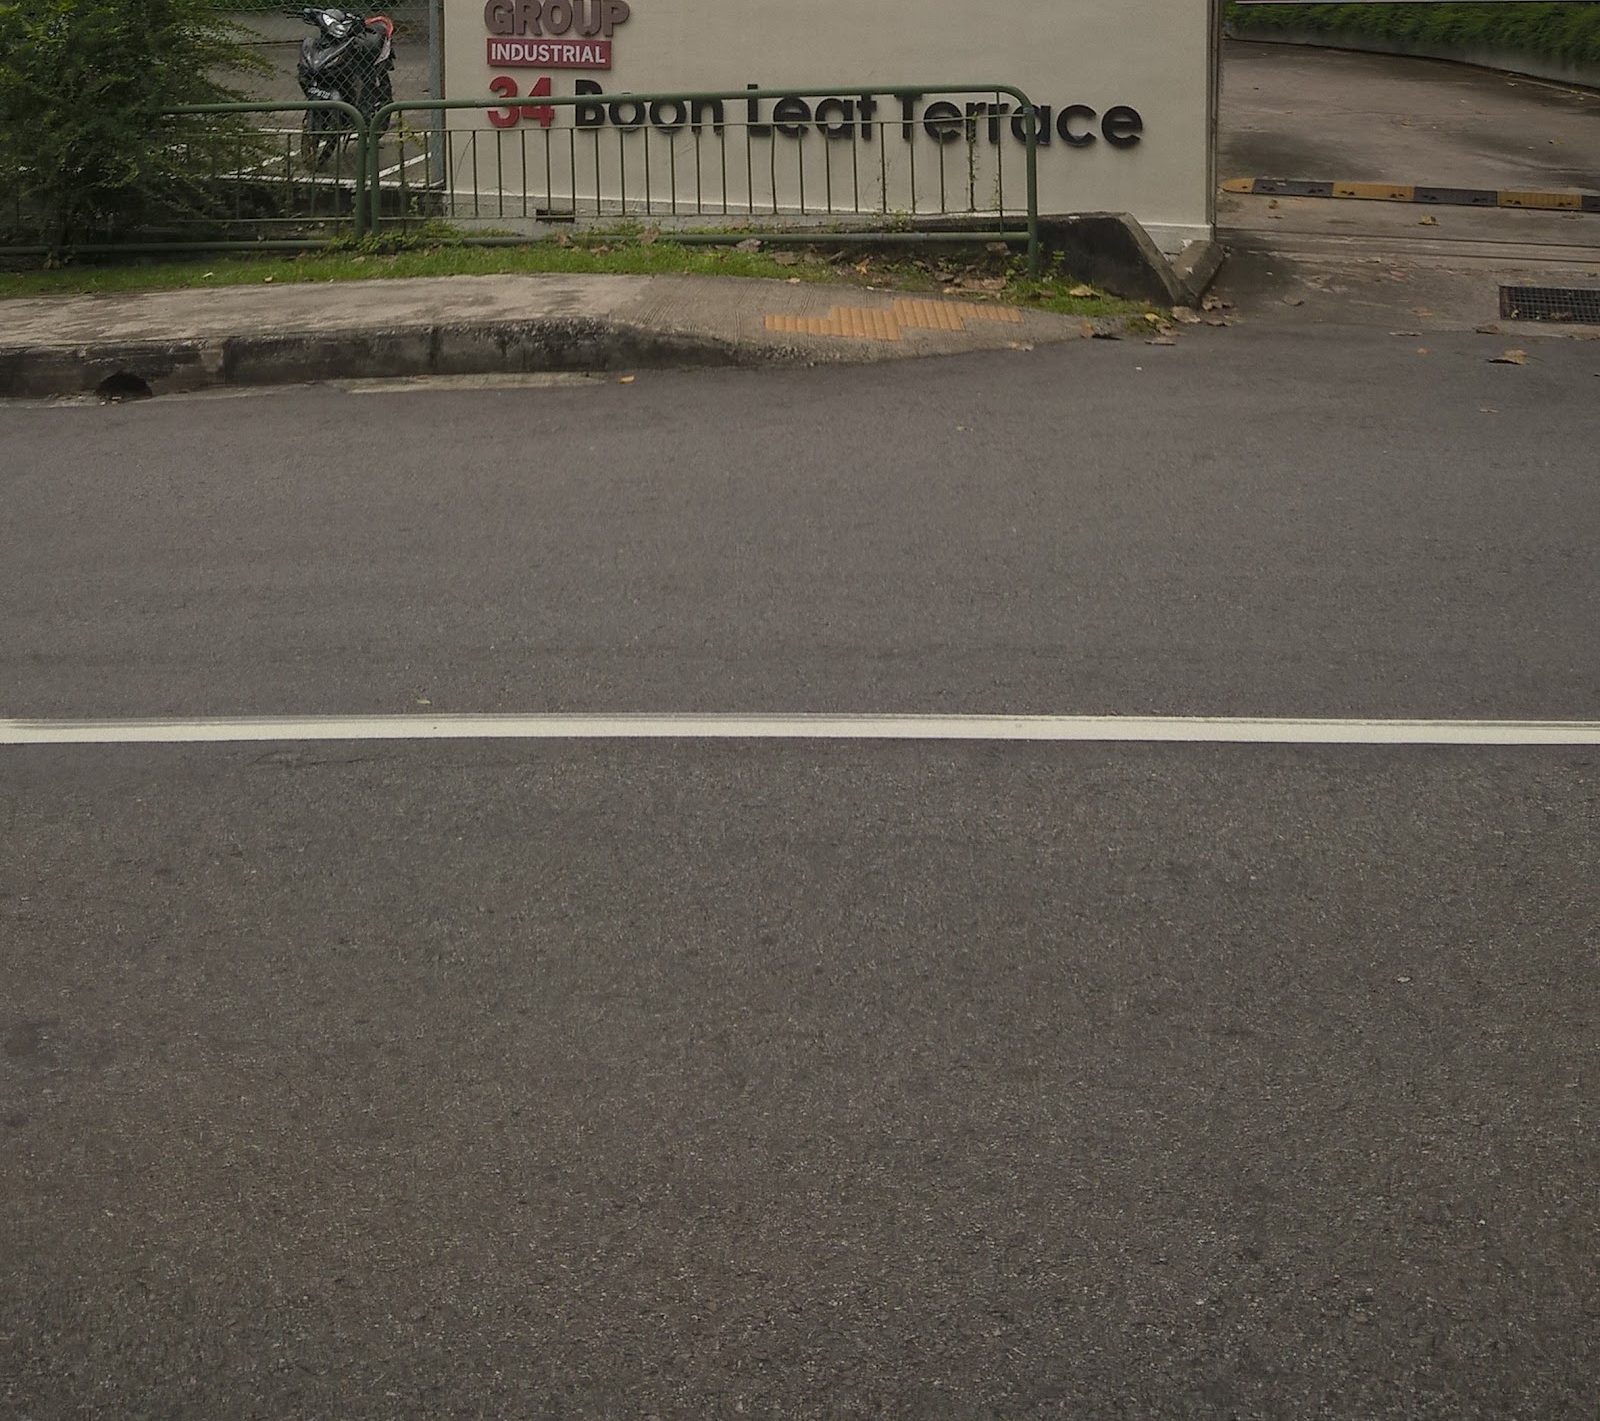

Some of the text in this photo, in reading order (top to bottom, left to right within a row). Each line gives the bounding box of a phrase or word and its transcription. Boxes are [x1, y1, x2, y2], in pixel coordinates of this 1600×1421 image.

[491, 43, 607, 64] INDUSTRIAL
[487, 76, 555, 128] 34
[575, 79, 725, 135] Boon
[895, 86, 1144, 149] Terrace
